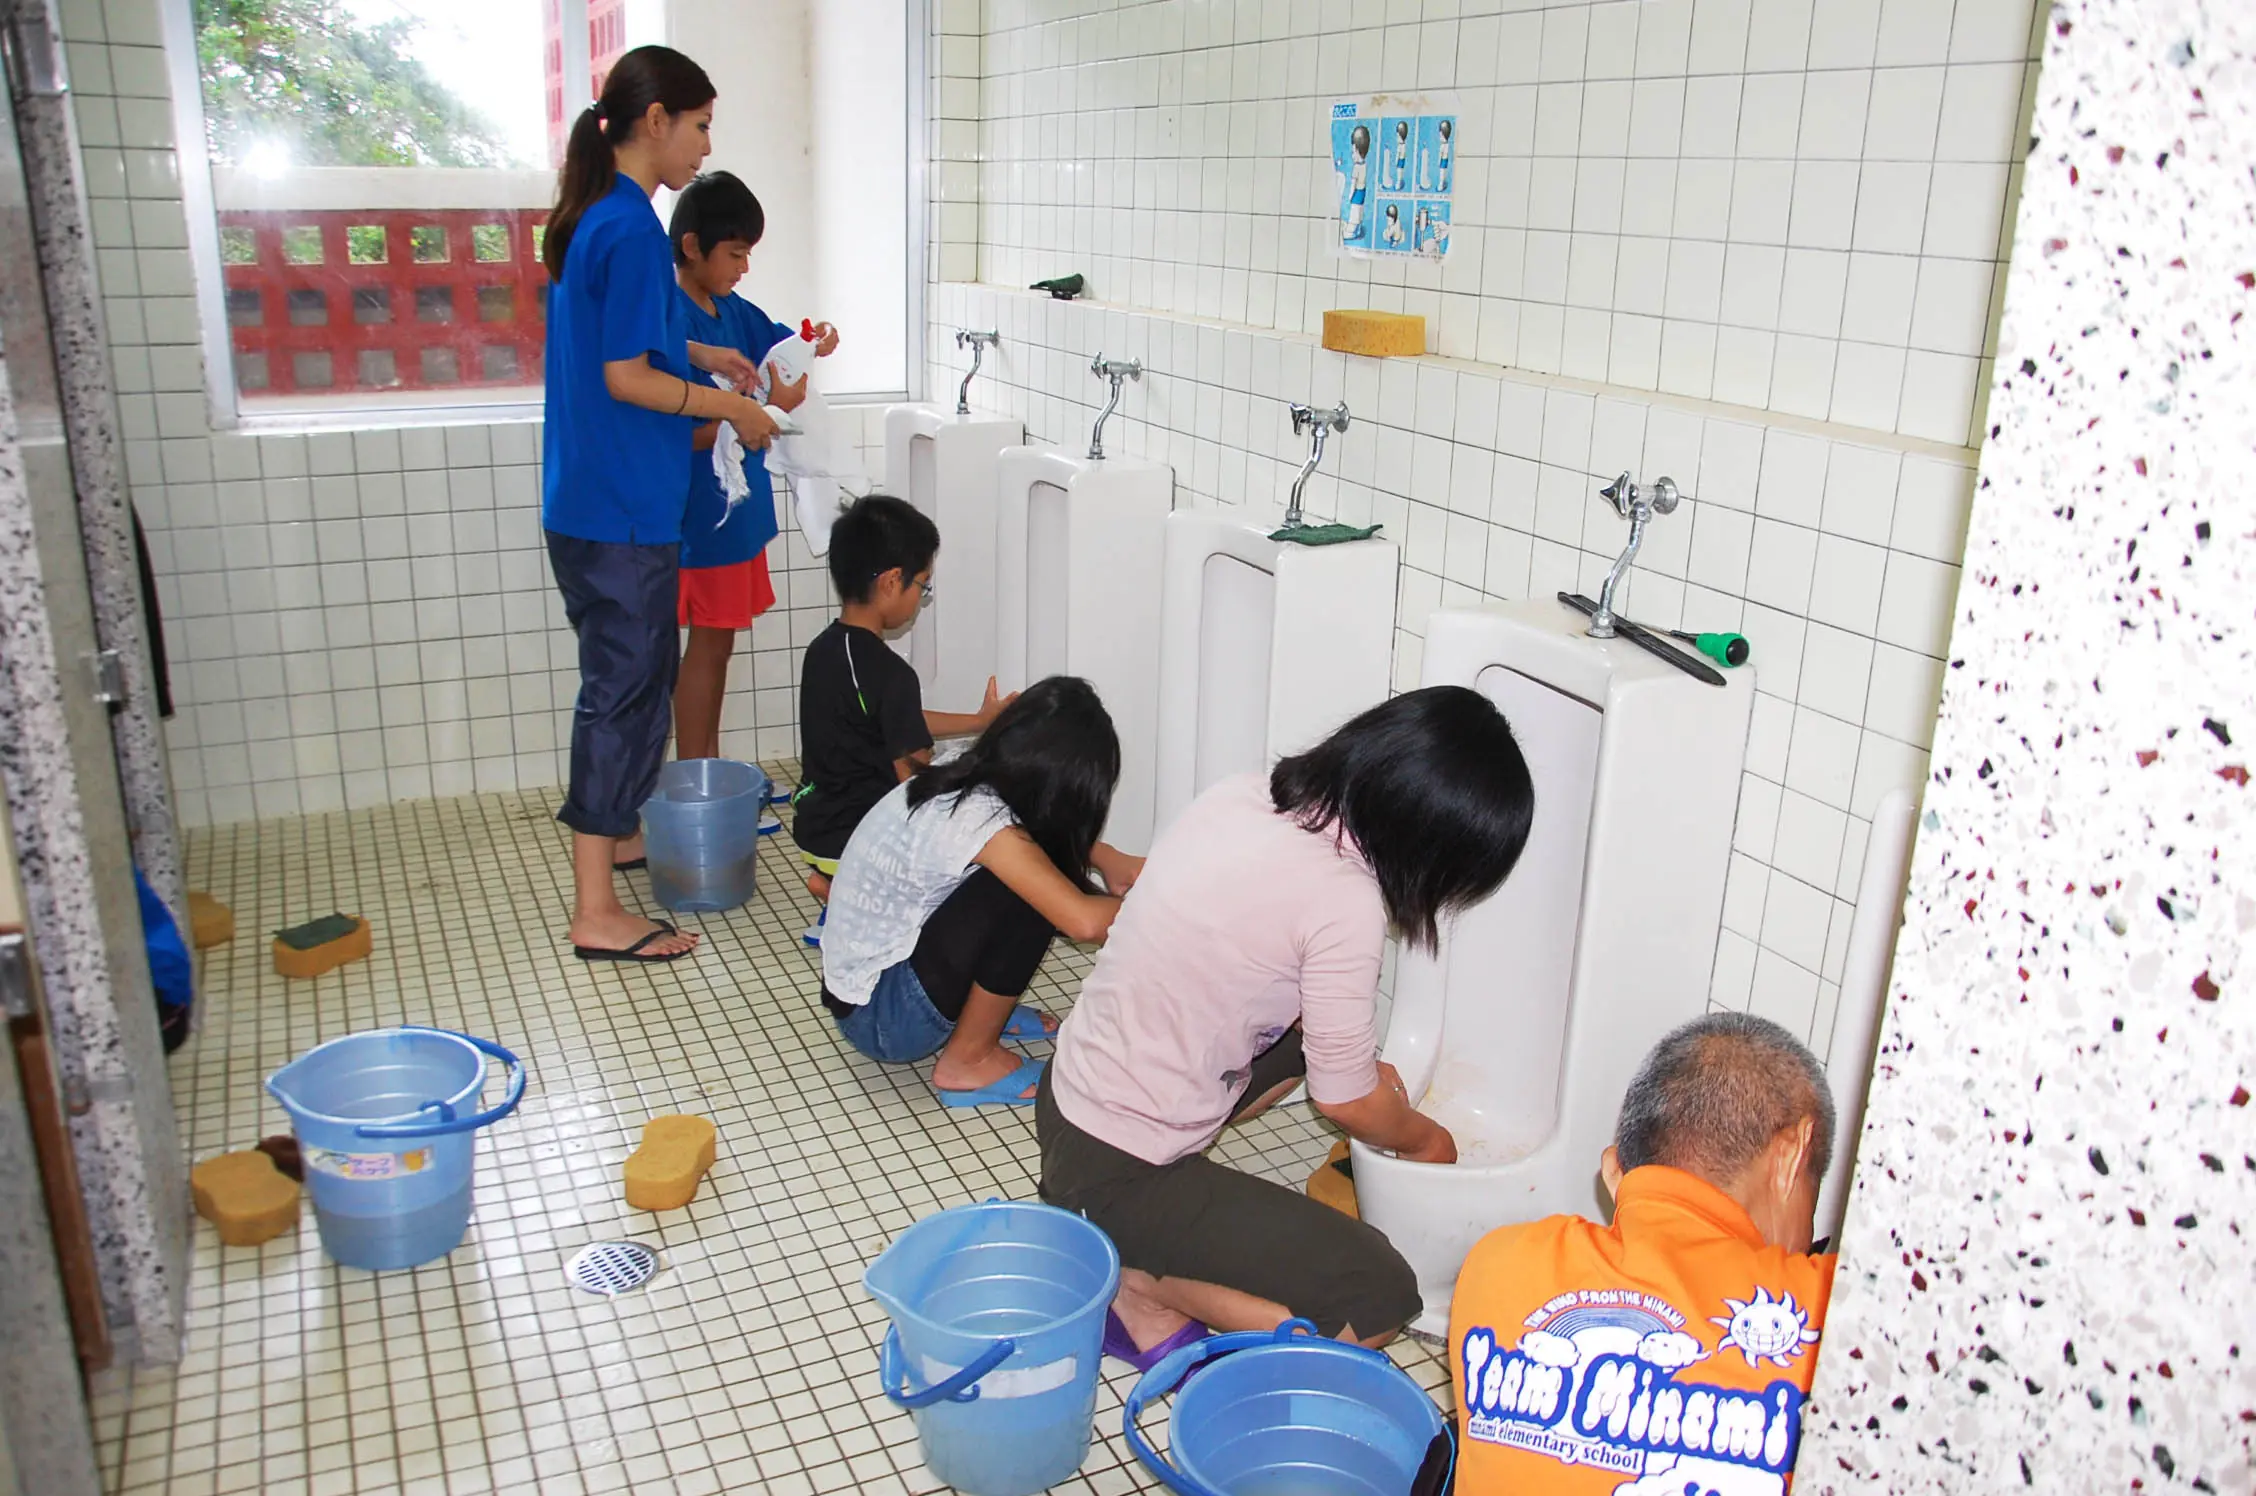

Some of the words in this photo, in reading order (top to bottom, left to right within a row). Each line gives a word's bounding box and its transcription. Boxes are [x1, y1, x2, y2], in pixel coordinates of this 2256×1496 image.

[1524, 1308, 1551, 1328] THE
[1579, 1290, 1618, 1304] FROM
[1619, 1291, 1640, 1305] THE
[1465, 1333, 1564, 1421] Team
[1582, 1359, 1789, 1468] Minami
[1498, 1422, 1579, 1459] elementary
[1583, 1445, 1640, 1470] school
